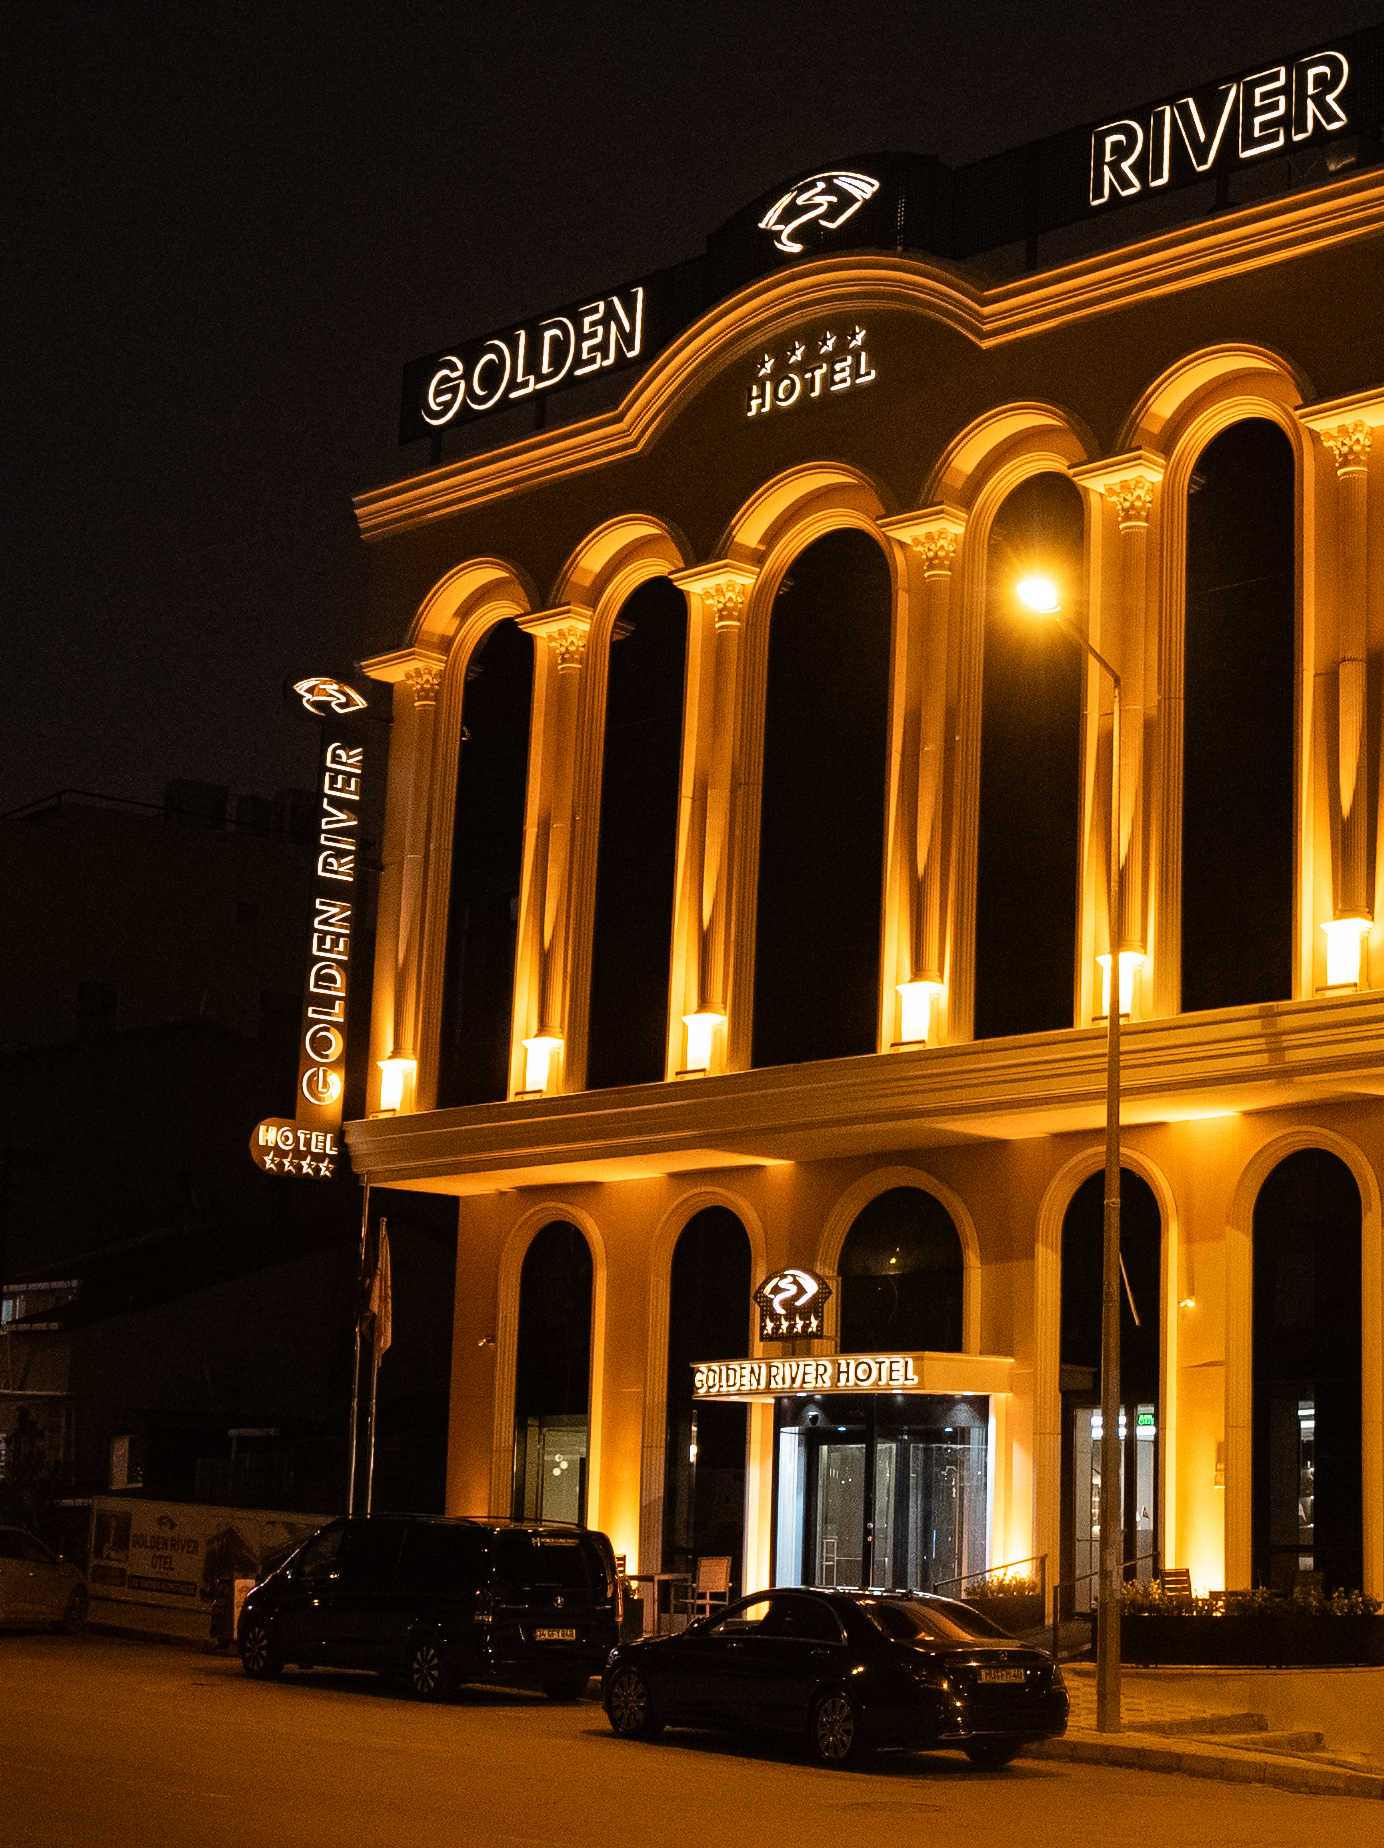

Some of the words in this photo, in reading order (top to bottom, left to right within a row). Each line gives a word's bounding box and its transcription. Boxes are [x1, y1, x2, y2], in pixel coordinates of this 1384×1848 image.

[1090, 50, 1349, 206] RIVER
[421, 286, 644, 426] GOLDEN
[746, 349, 876, 417] HOTEL
[318, 742, 363, 882] RIVER
[303, 897, 352, 1106] GOLDEN
[258, 1125, 338, 1155] HOTEL
[694, 1363, 766, 1393] GOLDEN
[769, 1360, 832, 1388] RIVER
[837, 1358, 919, 1386] HOTEL
[151, 1554, 174, 1571] OTEL
